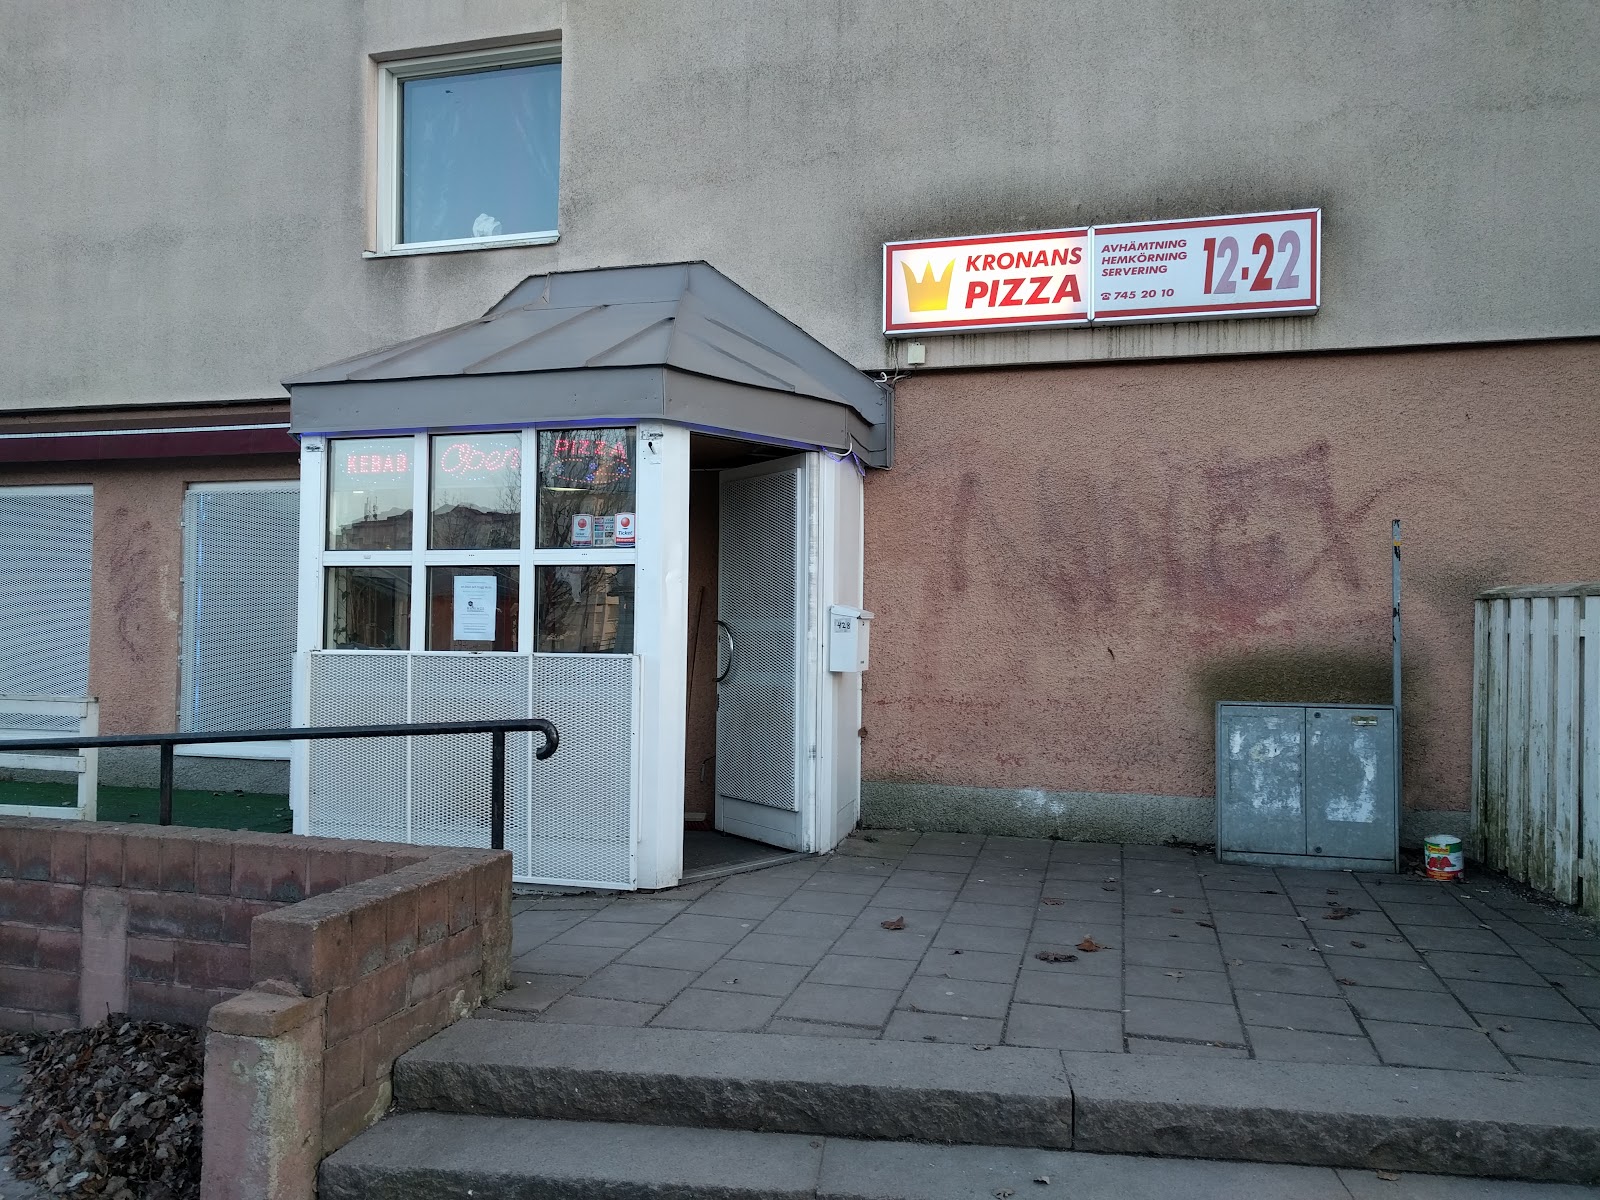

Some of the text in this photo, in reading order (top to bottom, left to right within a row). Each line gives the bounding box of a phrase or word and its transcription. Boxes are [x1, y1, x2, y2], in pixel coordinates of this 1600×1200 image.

[1101, 239, 1187, 253] AVHÄMTNING
[966, 246, 1082, 272] KRONANS
[1101, 251, 1187, 265] HEMKÖRNING
[1101, 265, 1168, 277] SERVERING
[965, 274, 1081, 309] PIZZA
[1113, 288, 1174, 300] 745 20 10
[554, 439, 627, 459] PIZZA
[347, 454, 408, 474] KEBAB
[441, 443, 520, 475] Open
[837, 621, 850, 629] 428
